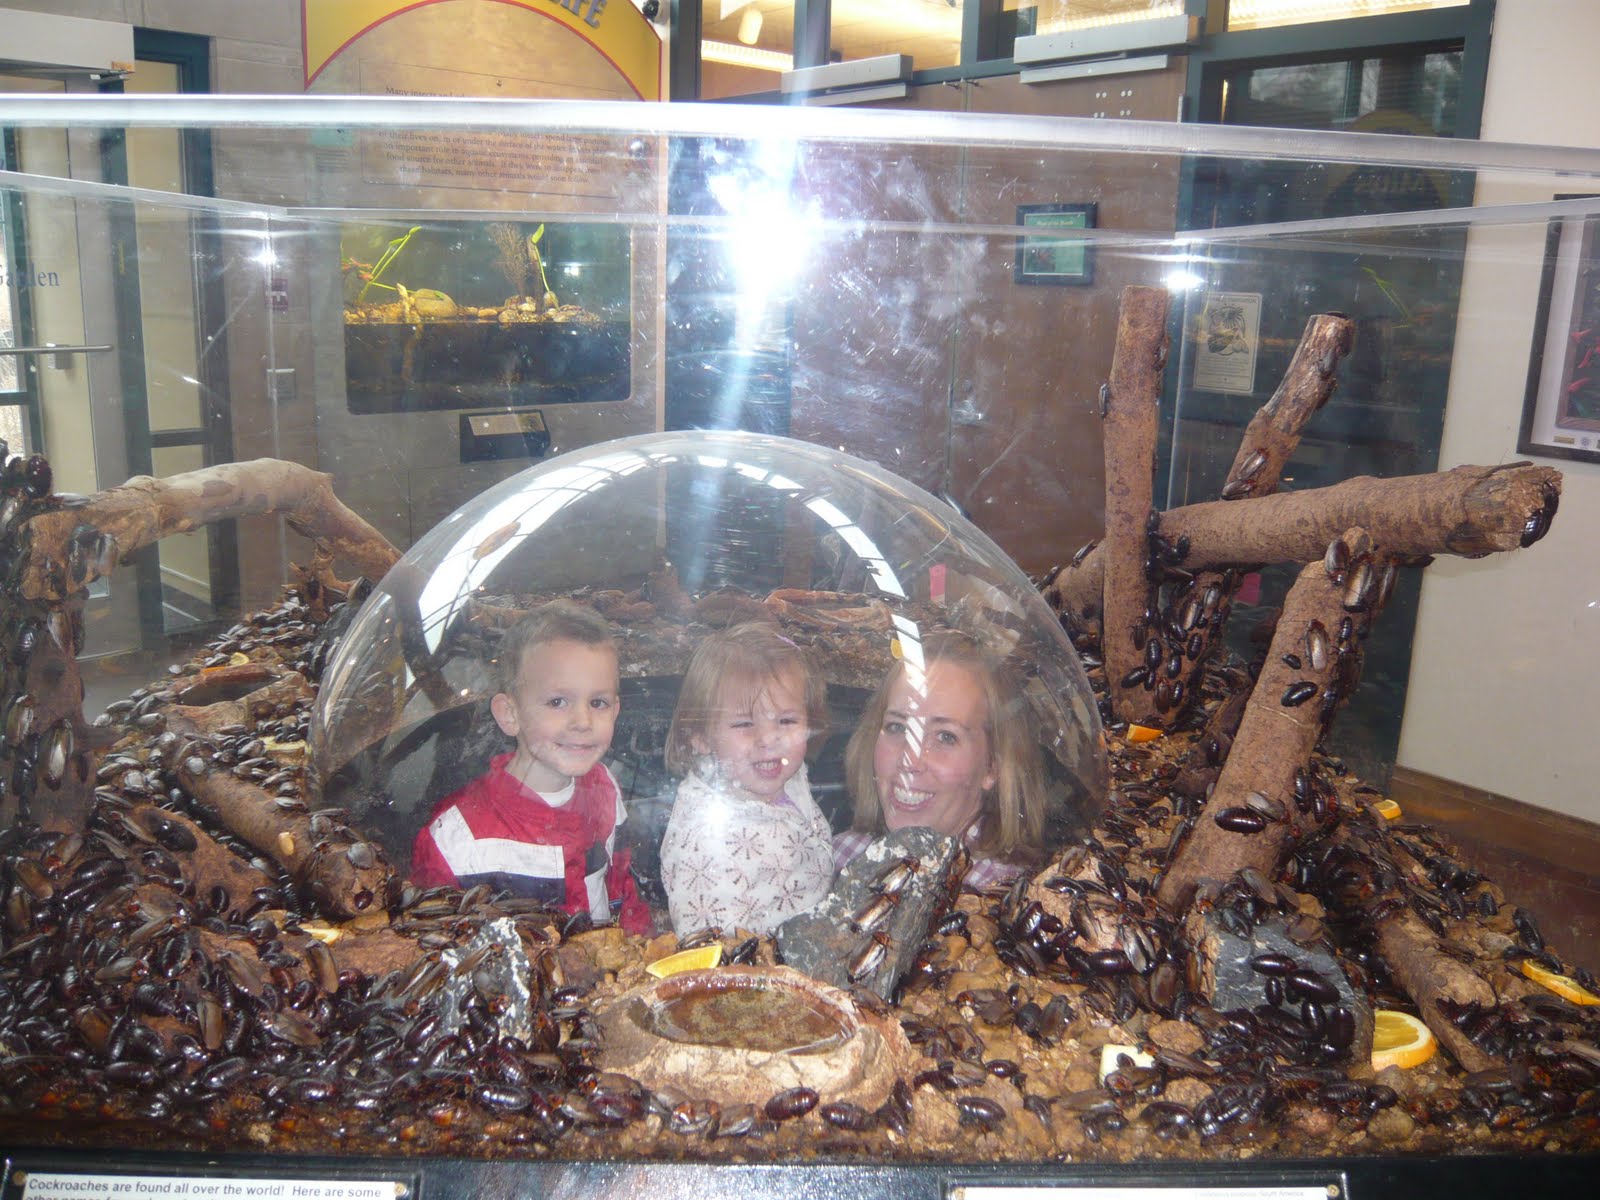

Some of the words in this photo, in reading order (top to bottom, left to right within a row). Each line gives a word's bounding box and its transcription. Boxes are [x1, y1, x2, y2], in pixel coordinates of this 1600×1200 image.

[385, 86, 409, 97] Many
[28, 1178, 109, 1192] Cockroaches
[112, 1183, 132, 1193] are
[135, 1180, 171, 1194] found
[174, 1181, 189, 1194] all
[192, 1184, 220, 1195] over
[223, 1183, 243, 1196] the
[246, 1184, 285, 1197] world!
[292, 1185, 321, 1198] Here
[324, 1187, 344, 1198] are
[347, 1189, 382, 1198] some
